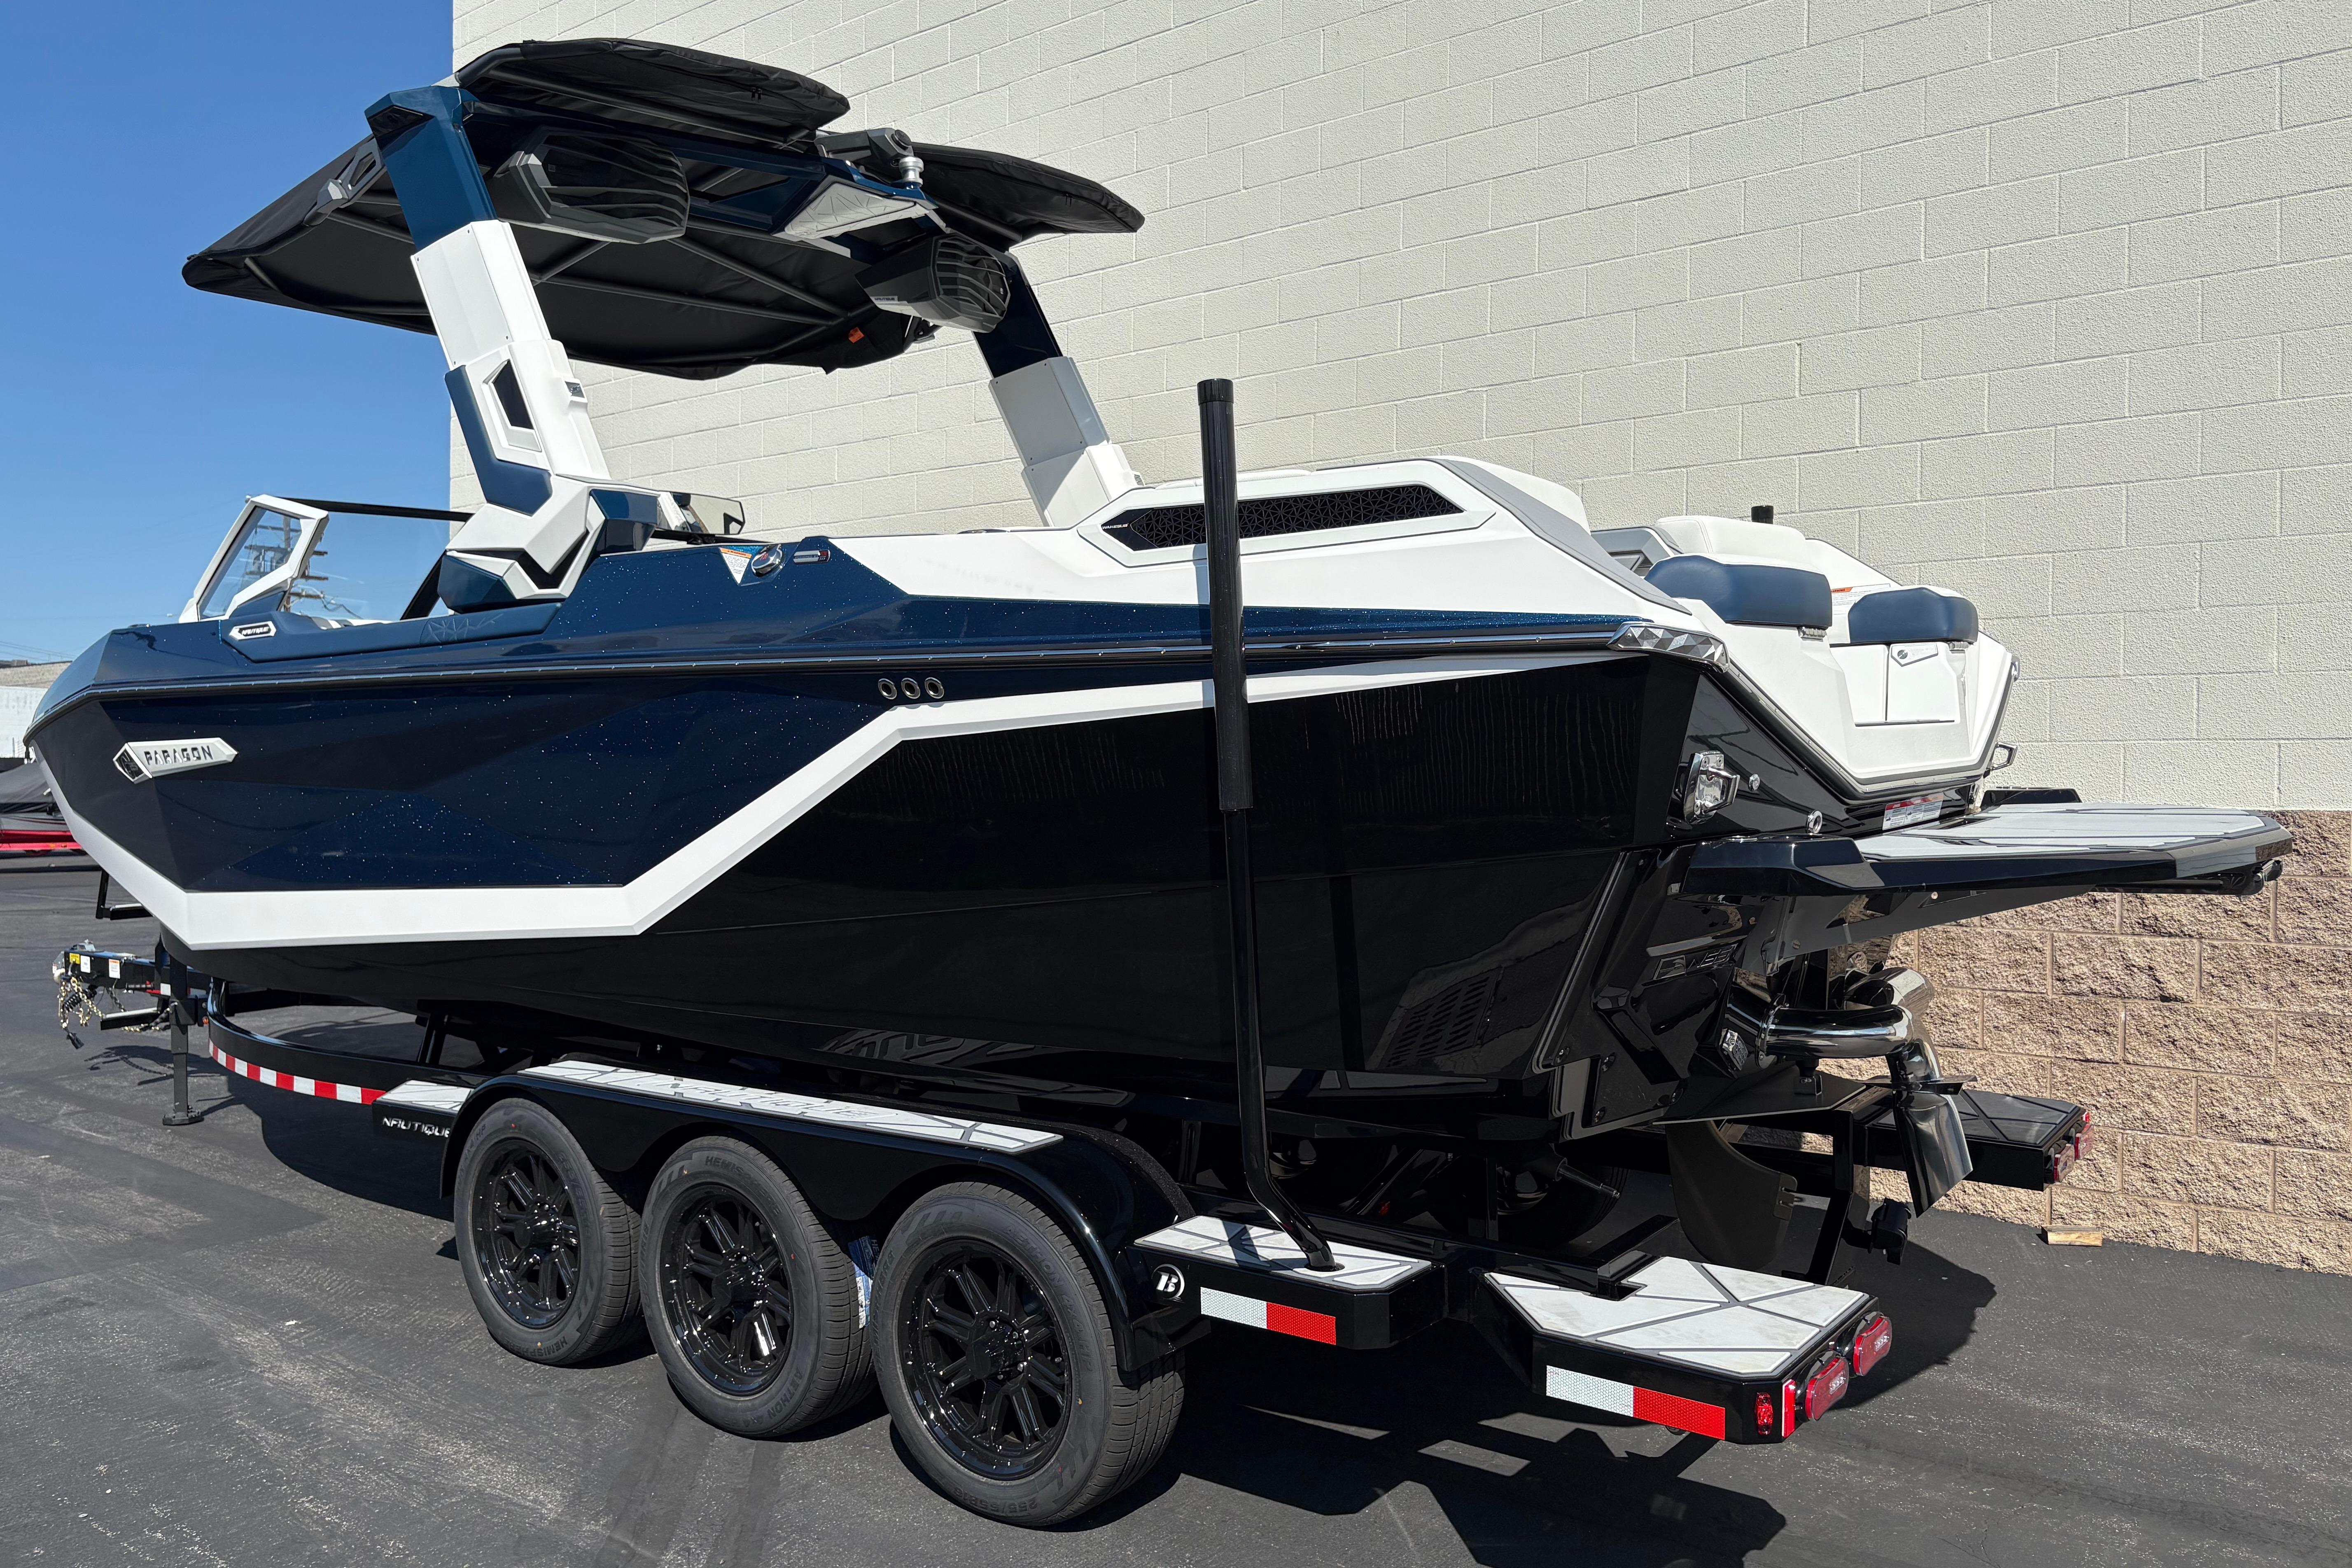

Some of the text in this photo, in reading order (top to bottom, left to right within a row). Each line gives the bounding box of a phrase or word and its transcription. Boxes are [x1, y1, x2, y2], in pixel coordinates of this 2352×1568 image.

[144, 745, 214, 765] PARAGON
[1003, 1225, 1066, 1288] AETHON
[767, 1367, 803, 1420] AETHON
